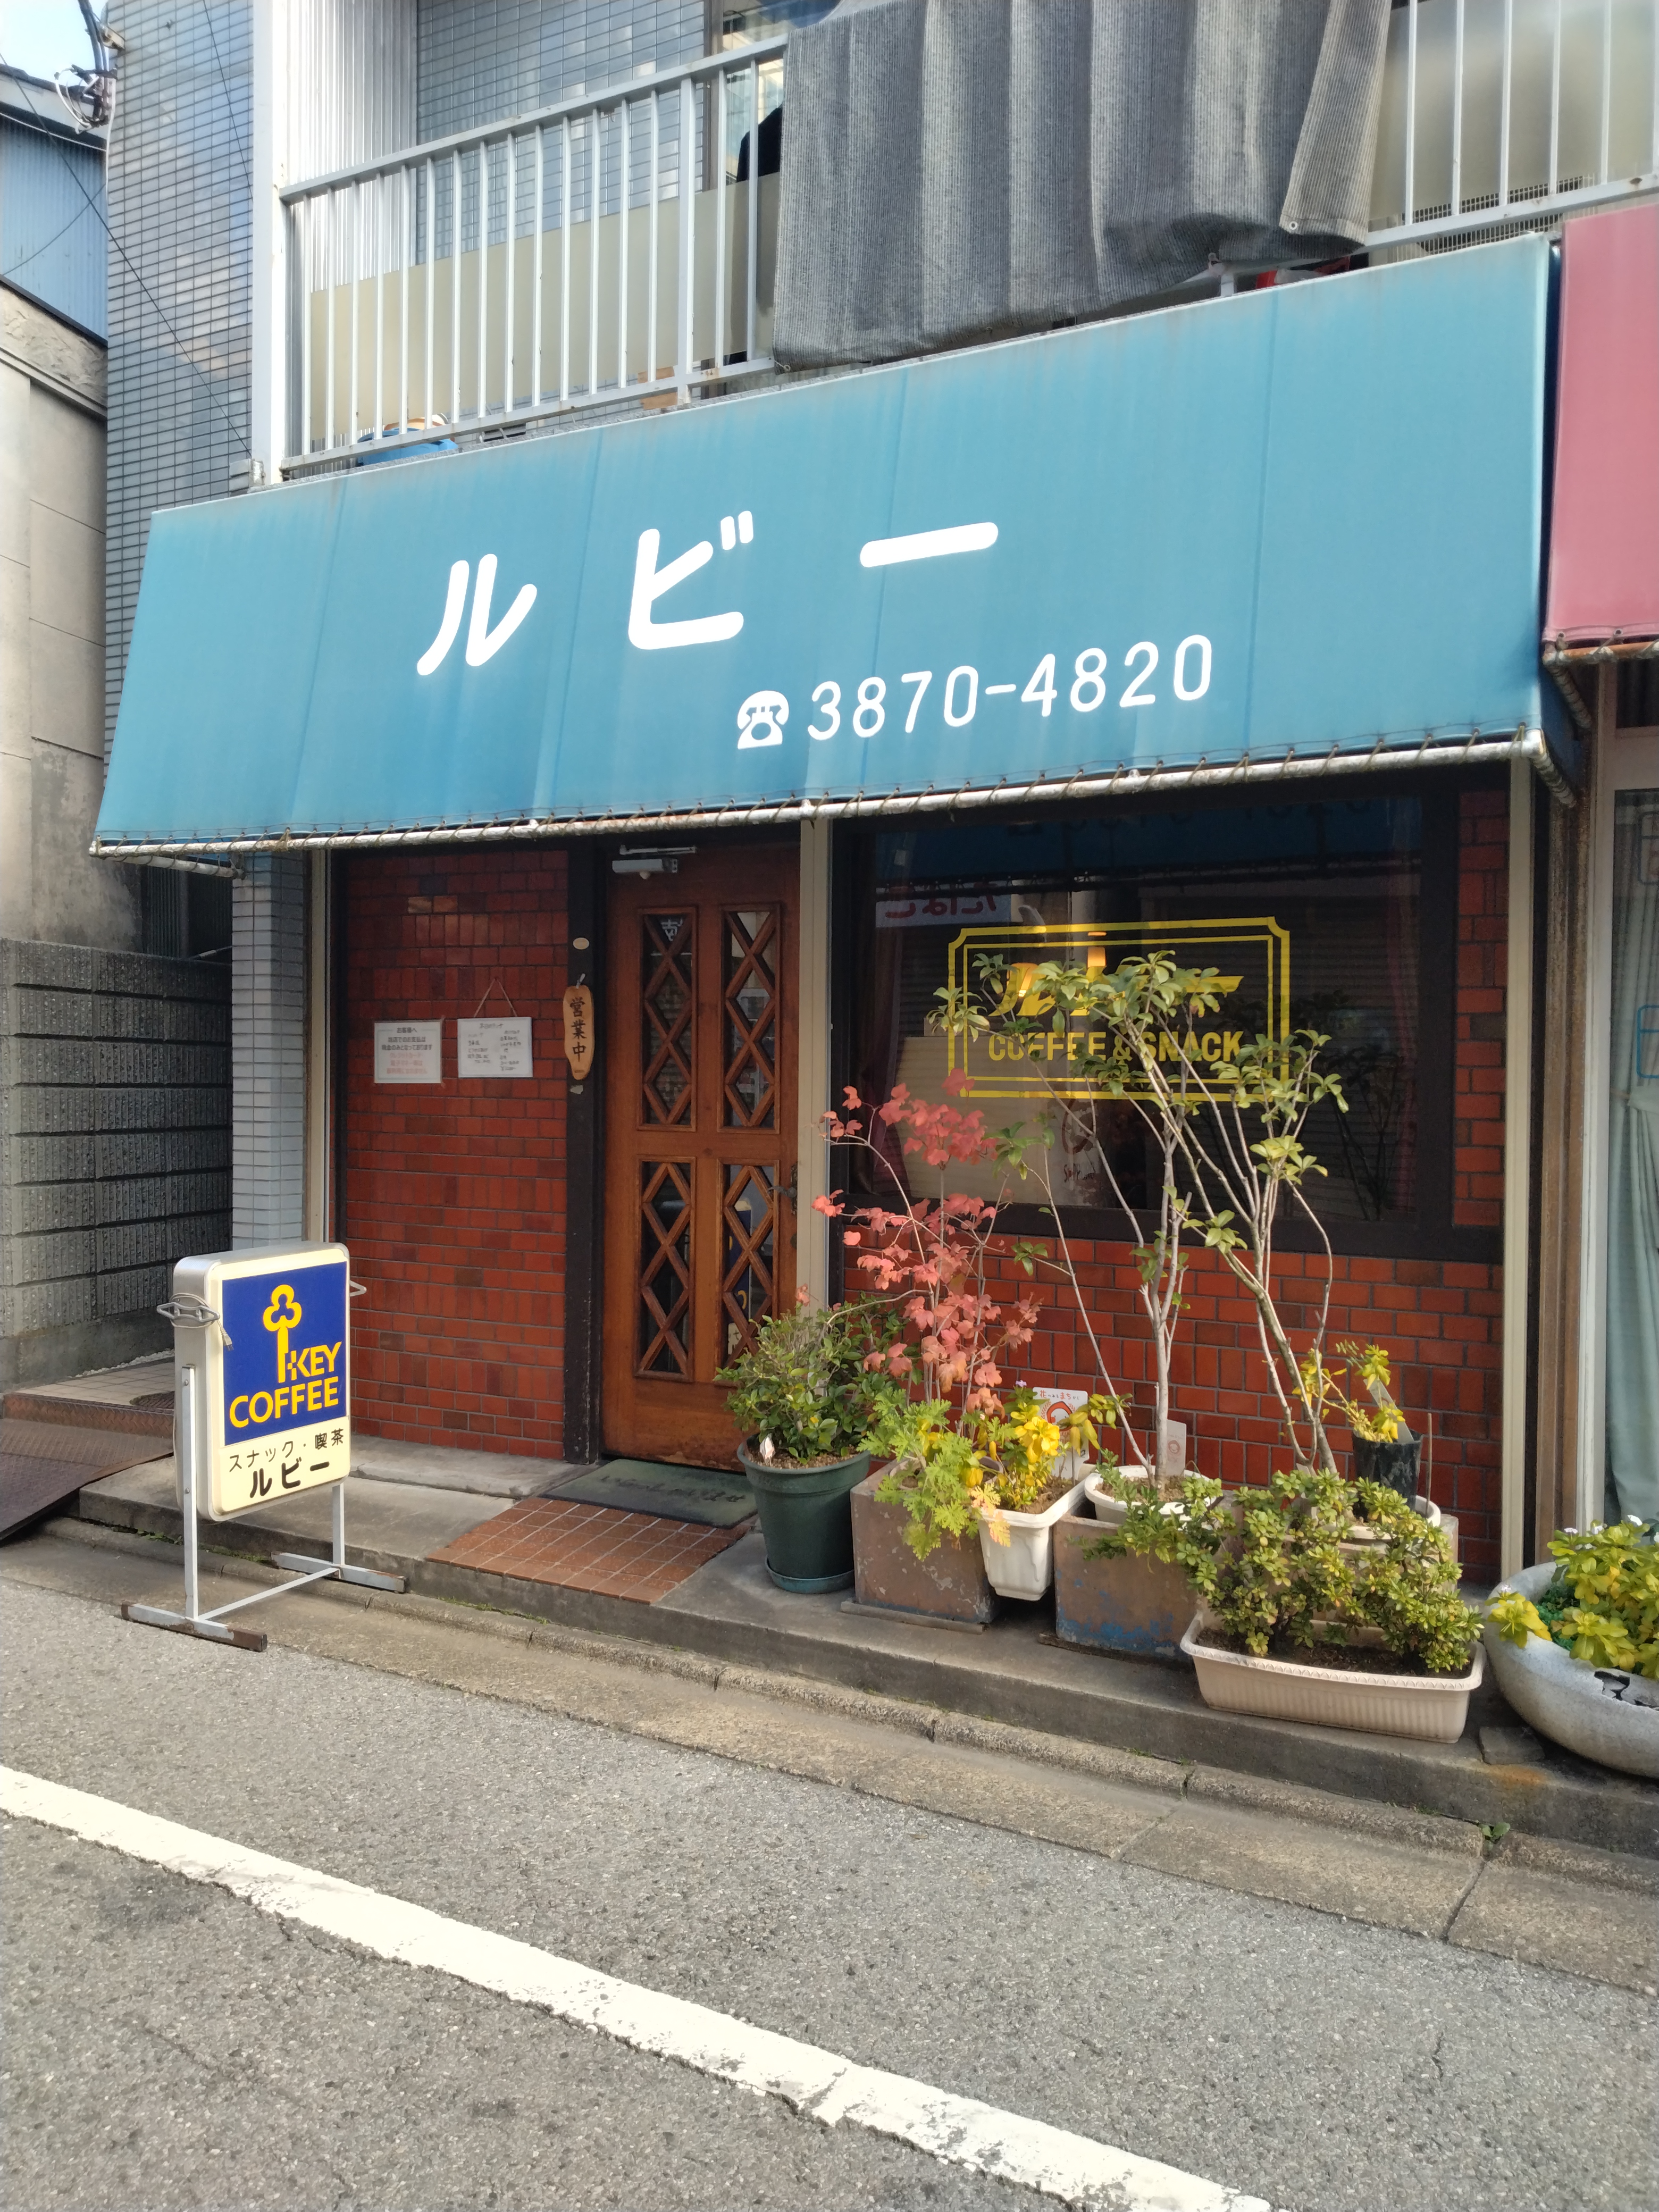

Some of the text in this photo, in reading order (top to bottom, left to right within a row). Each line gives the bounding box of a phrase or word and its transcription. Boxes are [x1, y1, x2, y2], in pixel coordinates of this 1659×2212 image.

[416, 510, 999, 676] ルビー
[807, 634, 1212, 741] 3870-4820
[569, 996, 587, 1062] 営業中
[989, 1031, 1107, 1061] COFFEE
[1142, 1030, 1244, 1062] SNACK
[288, 1342, 342, 1380] KEY
[229, 1376, 339, 1428] COFFEE
[229, 1428, 344, 1472] スナック・喫茶
[249, 1457, 330, 1498] ルビー
